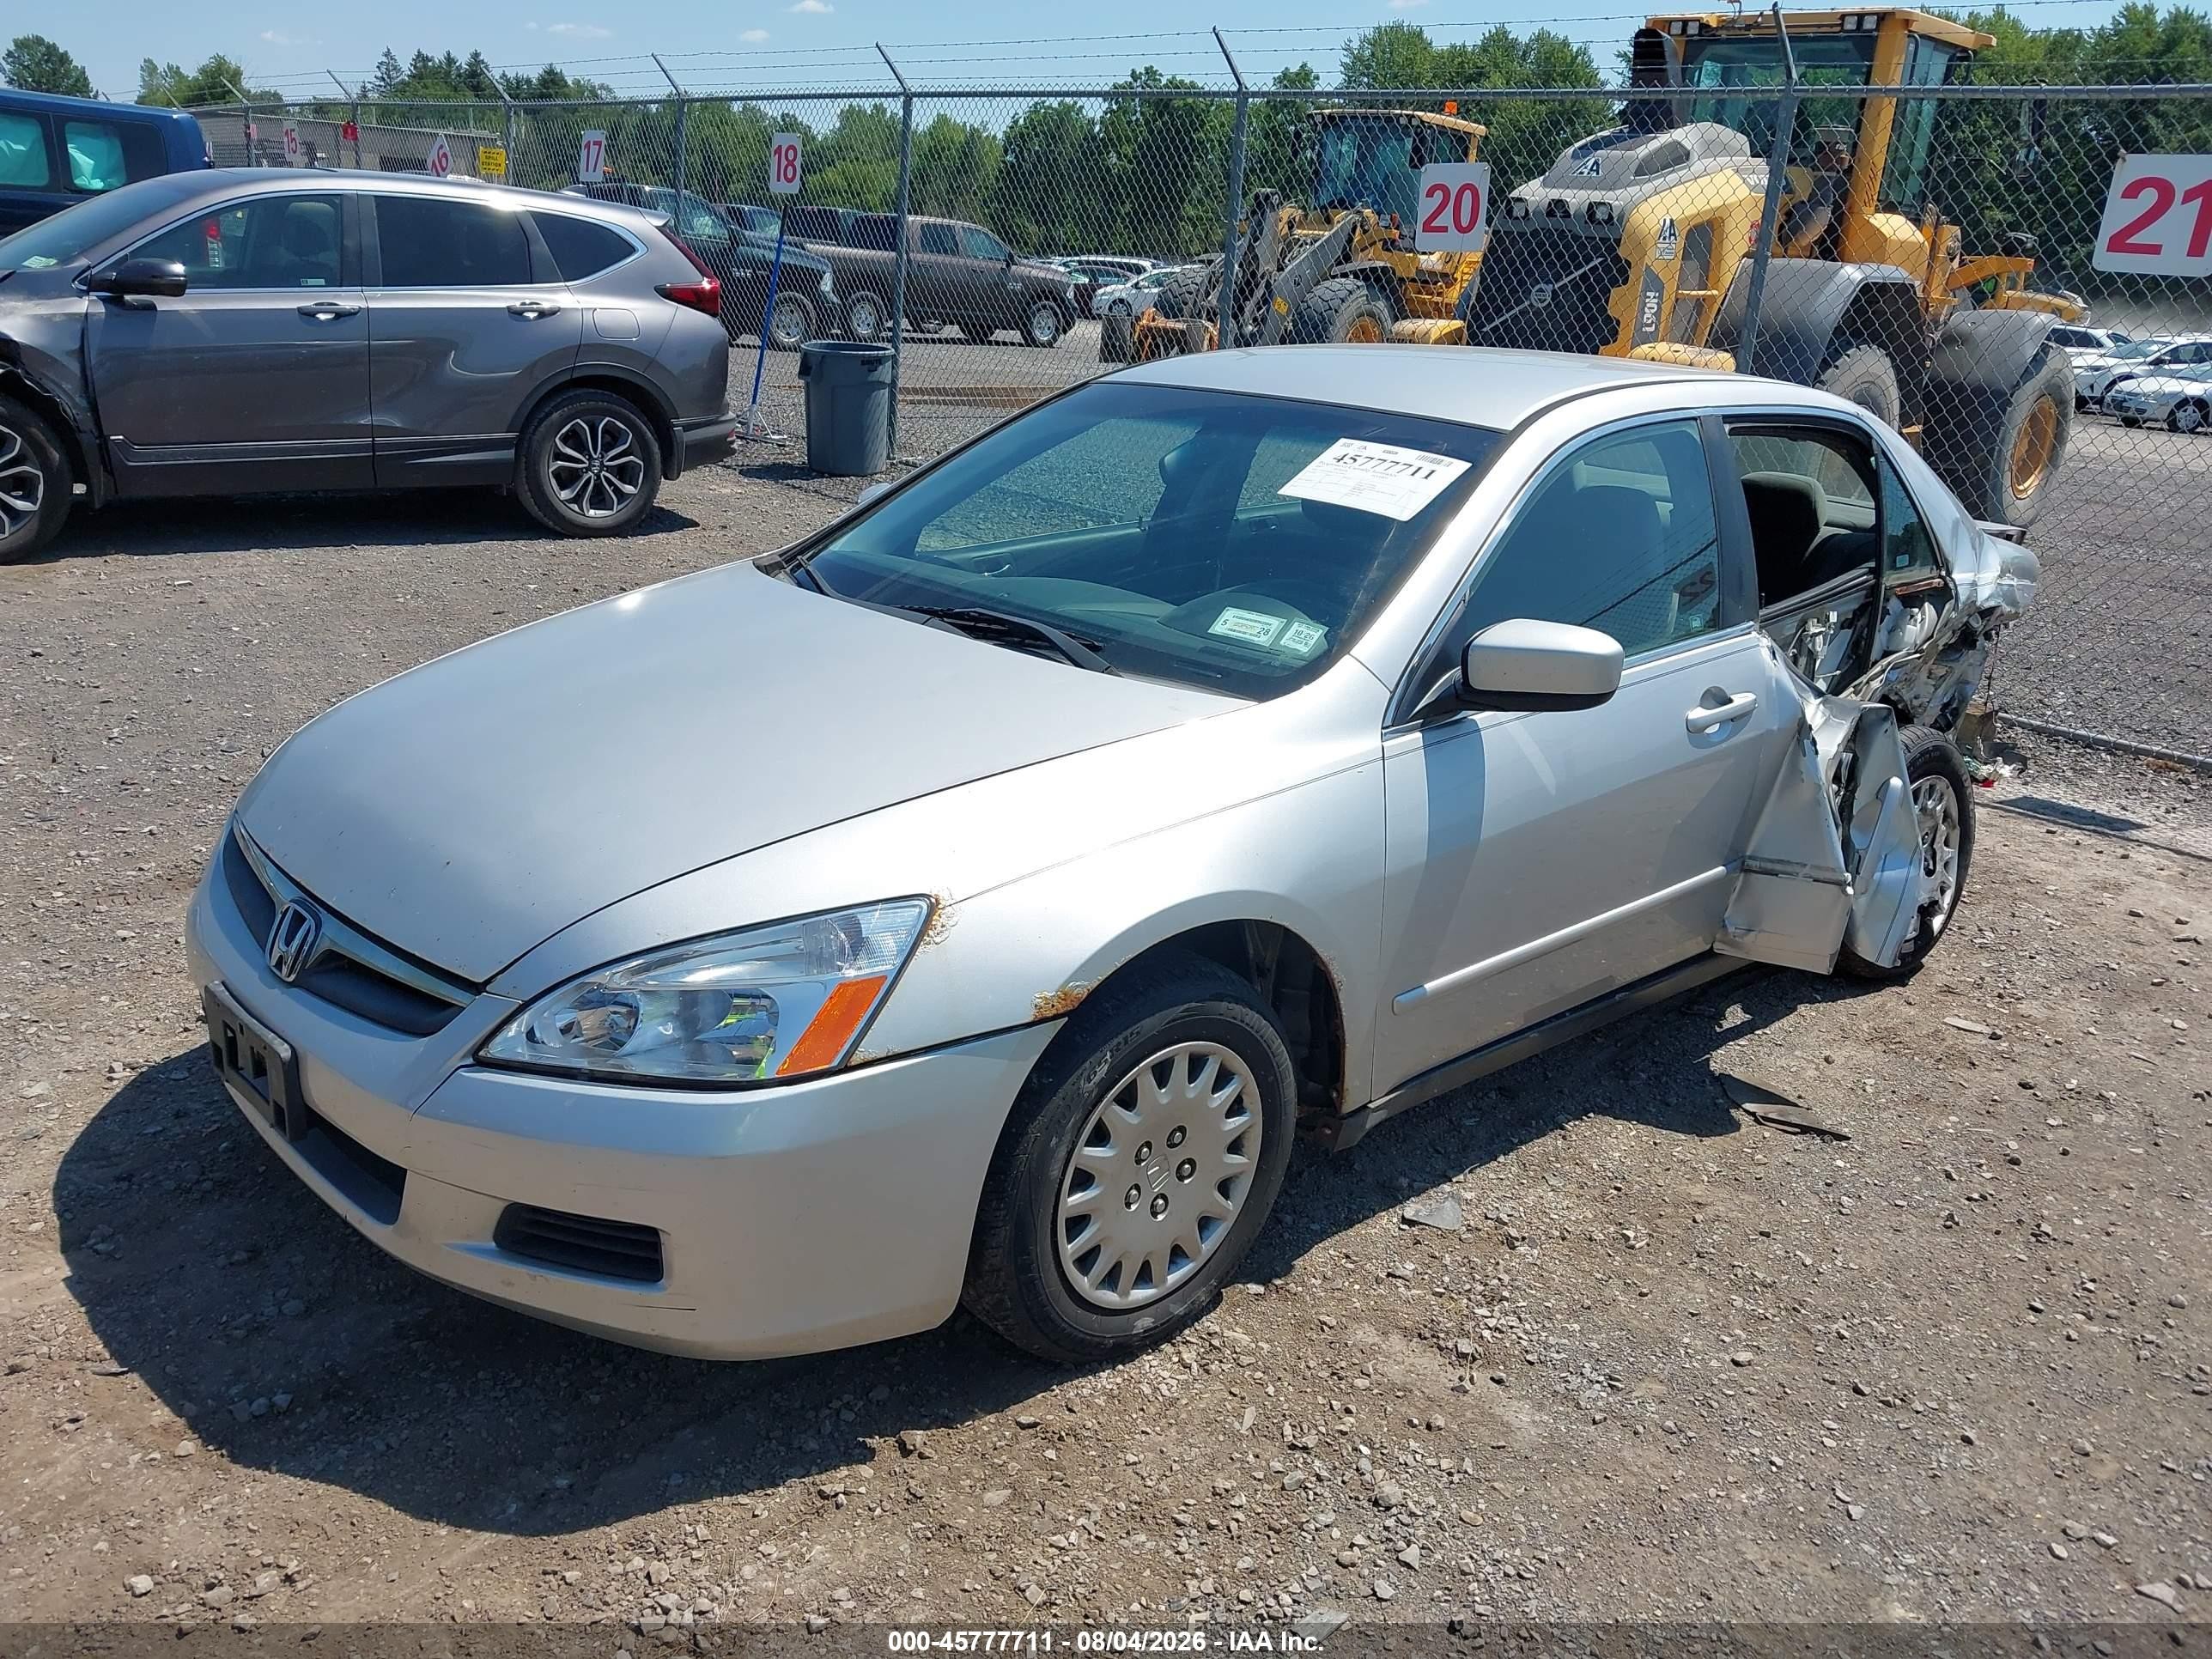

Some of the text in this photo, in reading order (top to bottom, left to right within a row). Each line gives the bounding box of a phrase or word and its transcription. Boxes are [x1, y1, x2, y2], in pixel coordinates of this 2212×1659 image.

[284, 128, 297, 155] 15
[583, 141, 603, 172] 17
[774, 144, 797, 183] 18
[1421, 183, 1481, 234] 20
[2106, 176, 2212, 258] 21
[1332, 453, 1437, 480] 45777711
[1220, 618, 1228, 627] 5
[1256, 627, 1272, 636] 28
